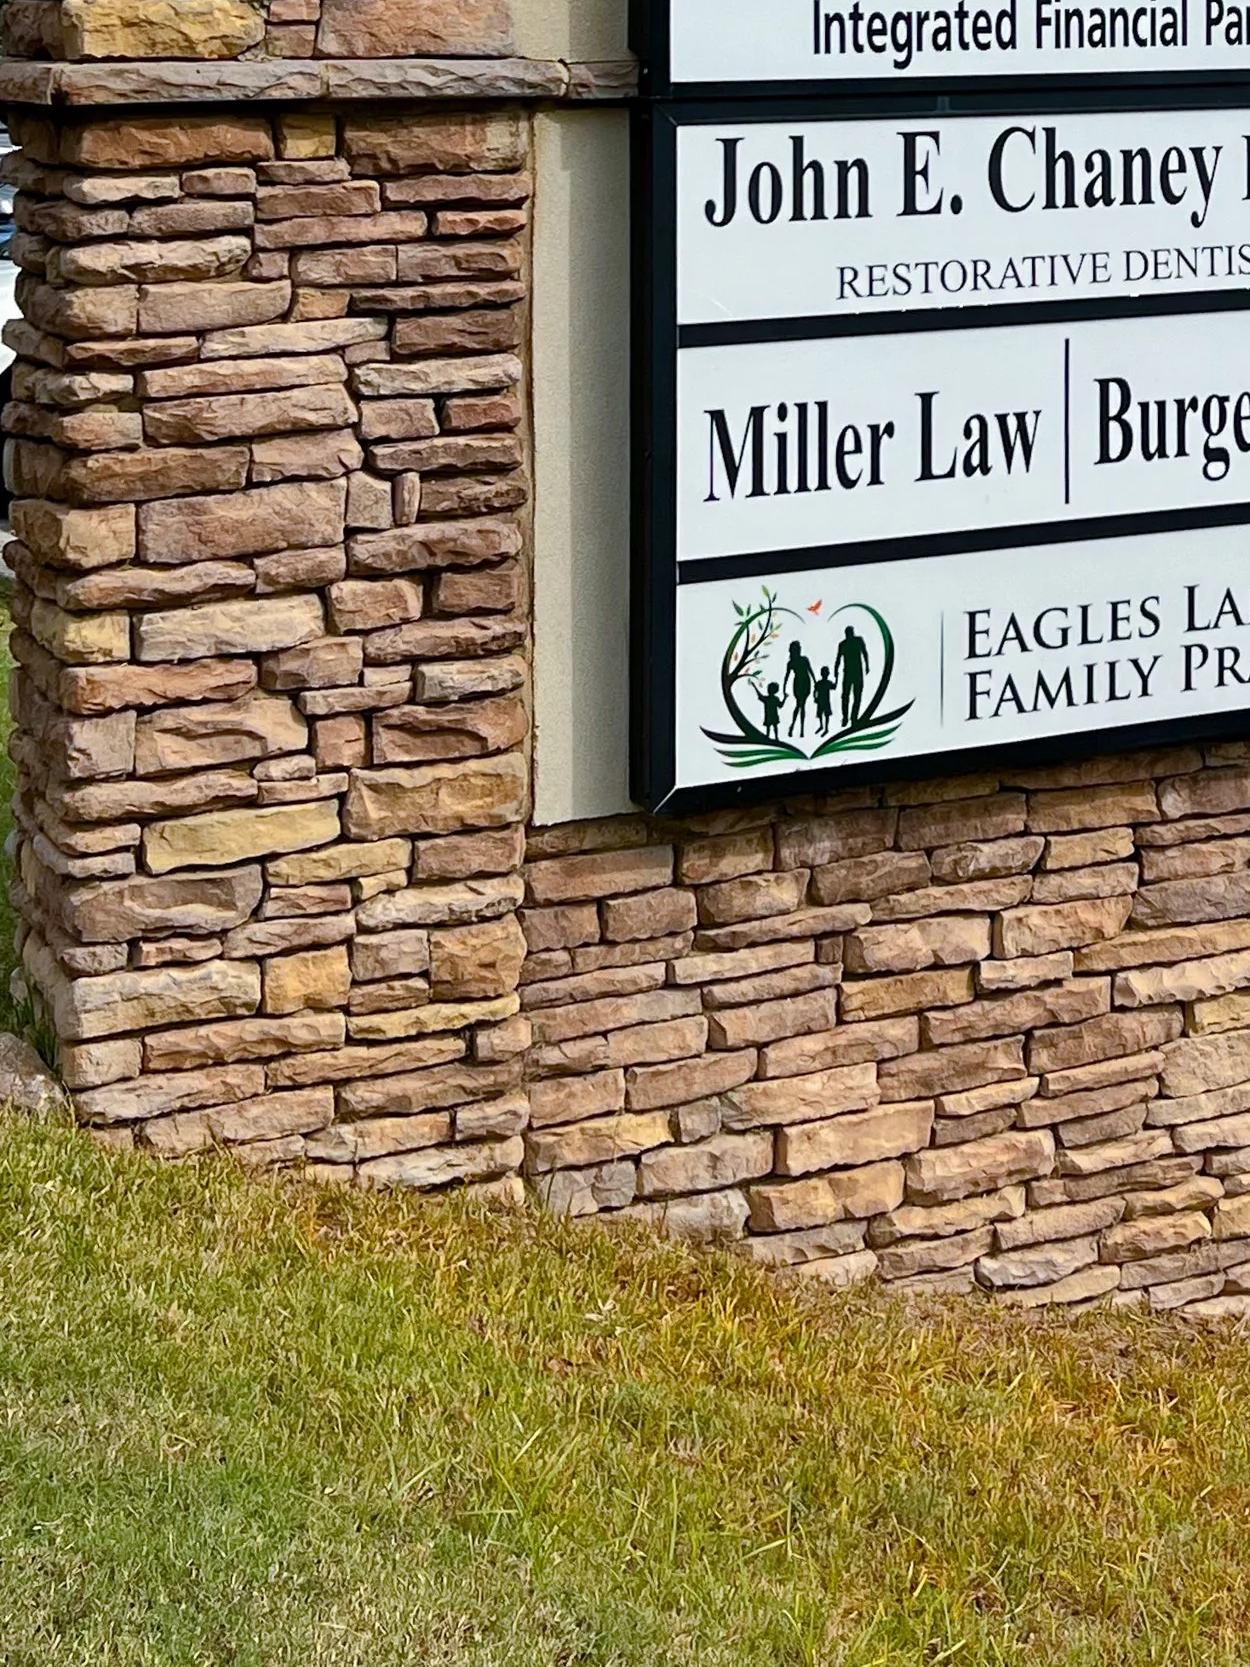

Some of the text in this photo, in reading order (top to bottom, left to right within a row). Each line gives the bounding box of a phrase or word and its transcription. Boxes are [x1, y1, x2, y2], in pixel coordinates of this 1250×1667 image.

[705, 136, 872, 227] John
[897, 131, 962, 216] E.
[988, 127, 1223, 228] Chaney
[837, 252, 1112, 301] RESTORATIVE
[703, 401, 894, 502] Miller
[915, 392, 1041, 482] Law
[964, 596, 1161, 660] EAGLES
[965, 653, 1162, 721] FAMILY
